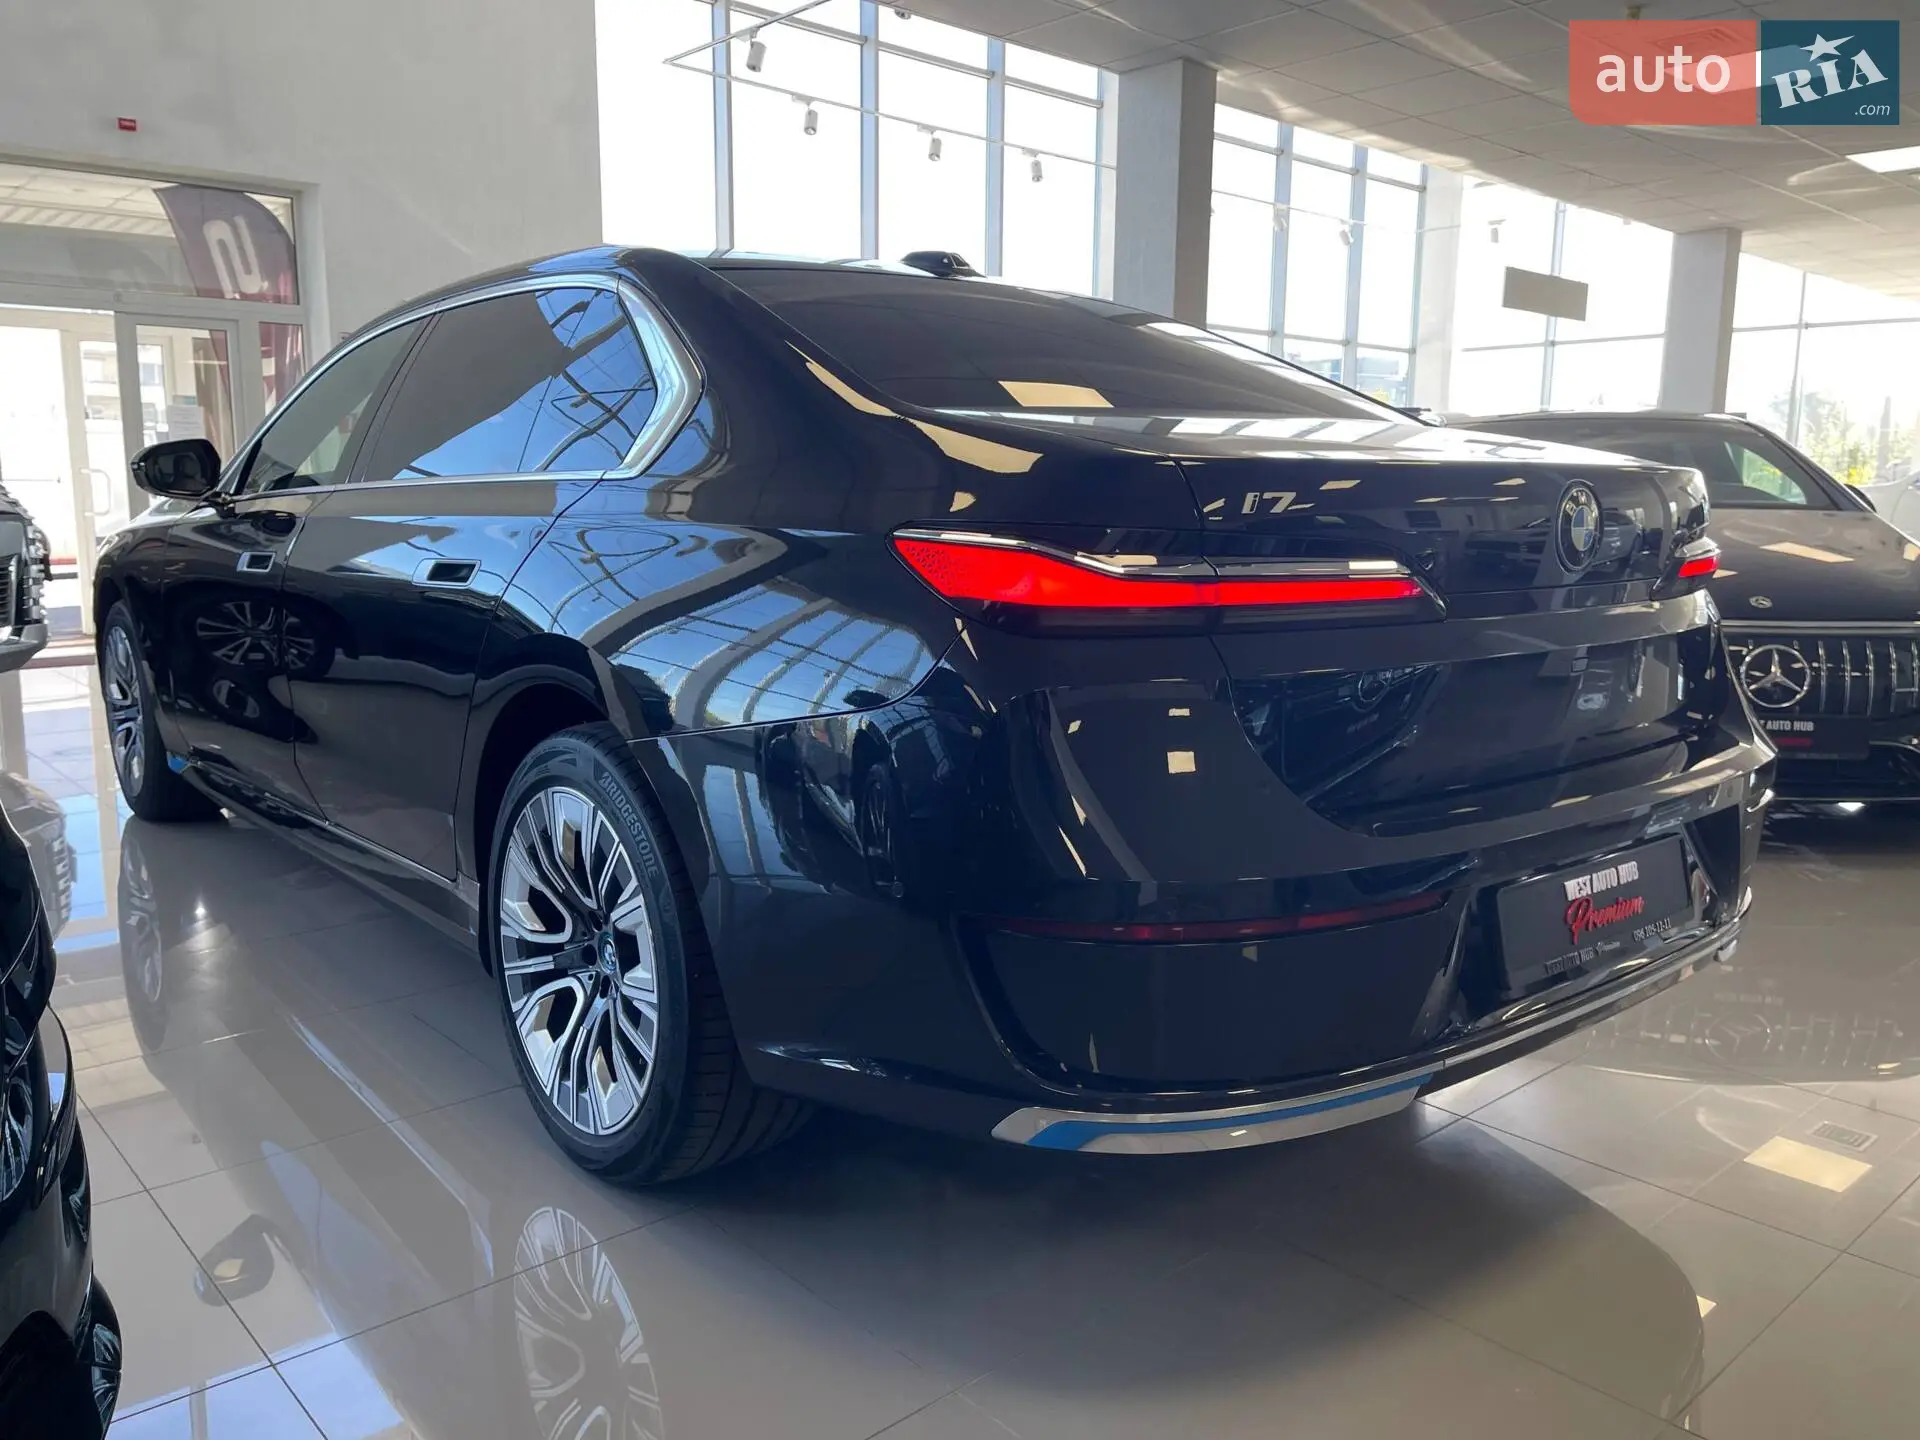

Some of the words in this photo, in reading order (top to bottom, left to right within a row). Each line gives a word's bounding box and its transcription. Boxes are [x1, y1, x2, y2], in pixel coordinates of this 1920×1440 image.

[1241, 491, 1297, 514] i7
[1766, 720, 1792, 731] AUTO
[1793, 720, 1814, 732] HUB
[600, 771, 660, 877] BRIDGESTONE
[1564, 874, 1592, 901] WEST
[1592, 868, 1617, 893] AUTO
[1617, 861, 1639, 885] HUB
[1566, 896, 1644, 944] Premium
